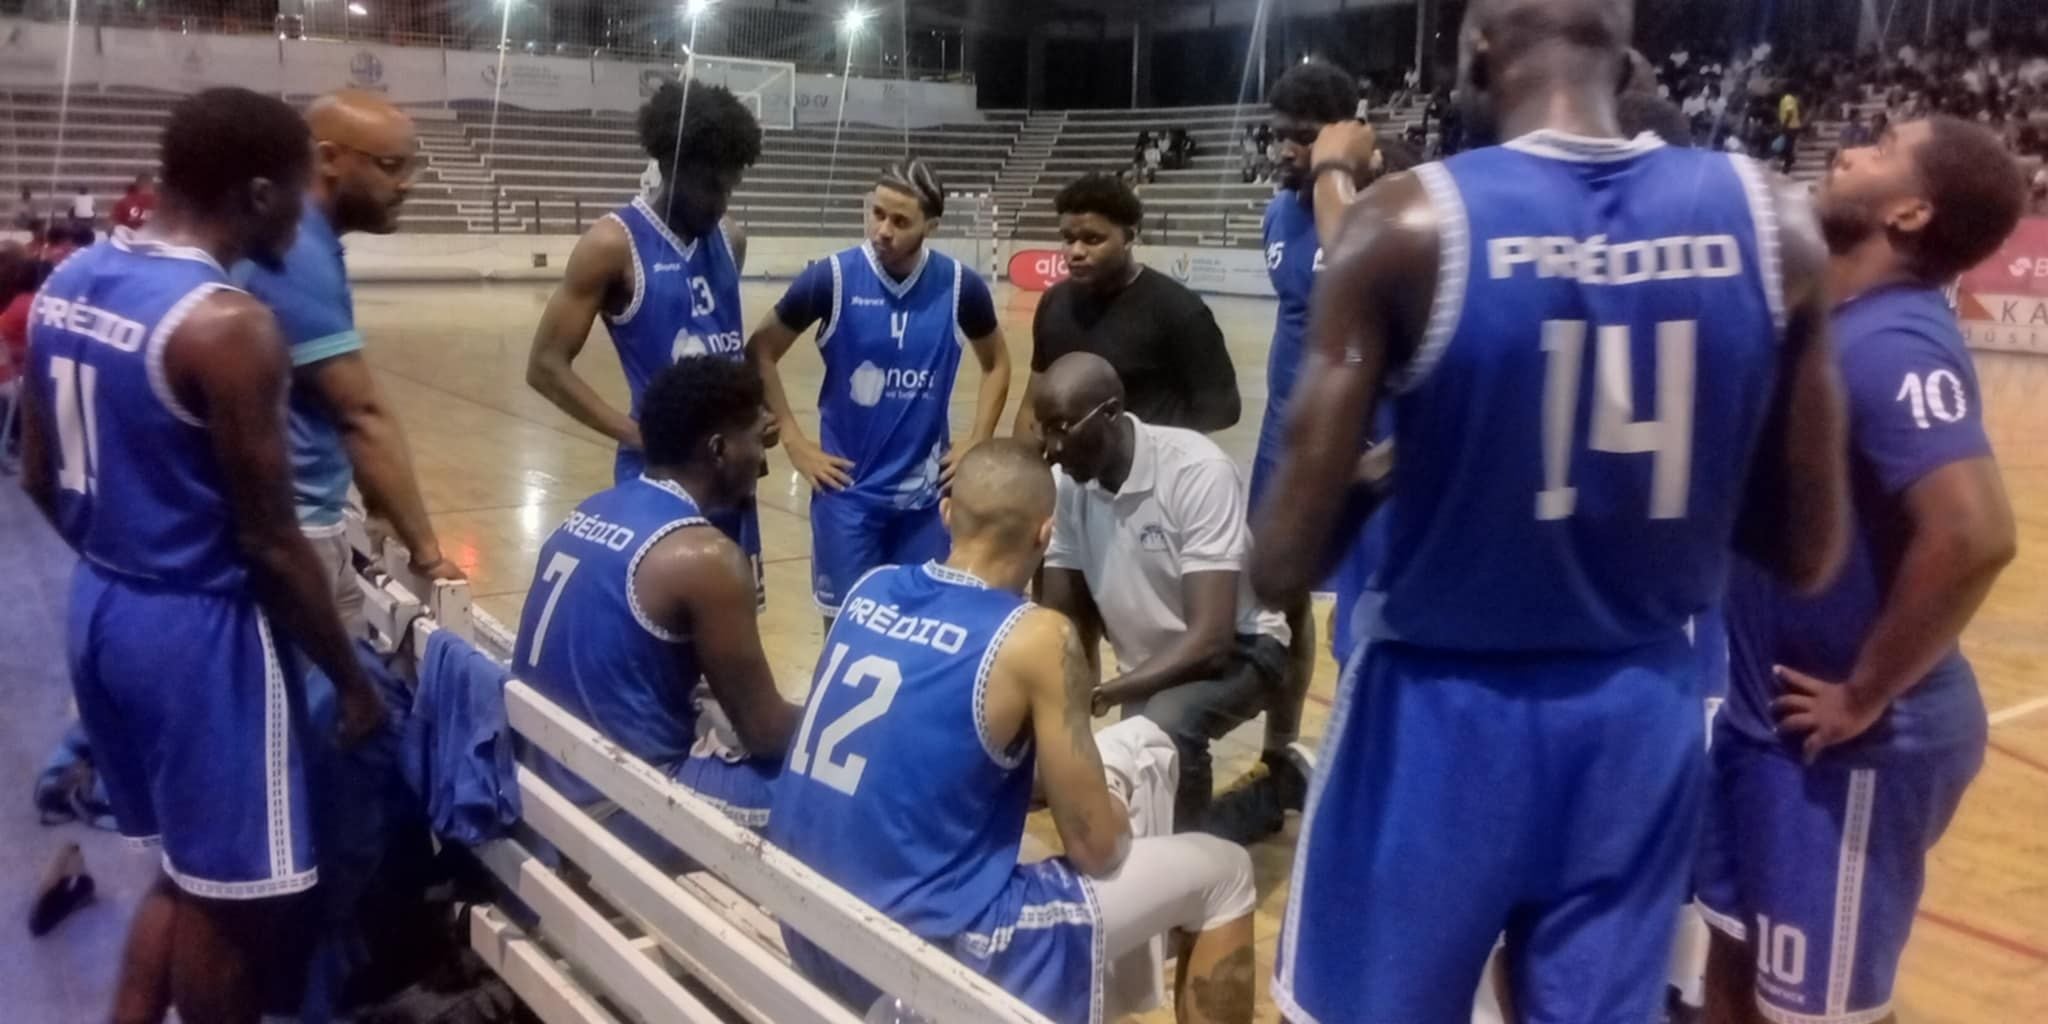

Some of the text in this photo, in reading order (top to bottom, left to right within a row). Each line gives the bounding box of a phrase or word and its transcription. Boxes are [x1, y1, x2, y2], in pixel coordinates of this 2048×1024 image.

[1487, 234, 1742, 285] PRÉDIO
[686, 275, 715, 318] 13
[890, 311, 908, 350] 4
[50, 356, 97, 496] 11
[1535, 319, 1697, 520] 14
[1897, 369, 1966, 428] 10
[528, 551, 580, 668] 7
[848, 597, 968, 655] PRÉDIO
[790, 642, 902, 796] 12
[1757, 913, 1806, 984] 10
